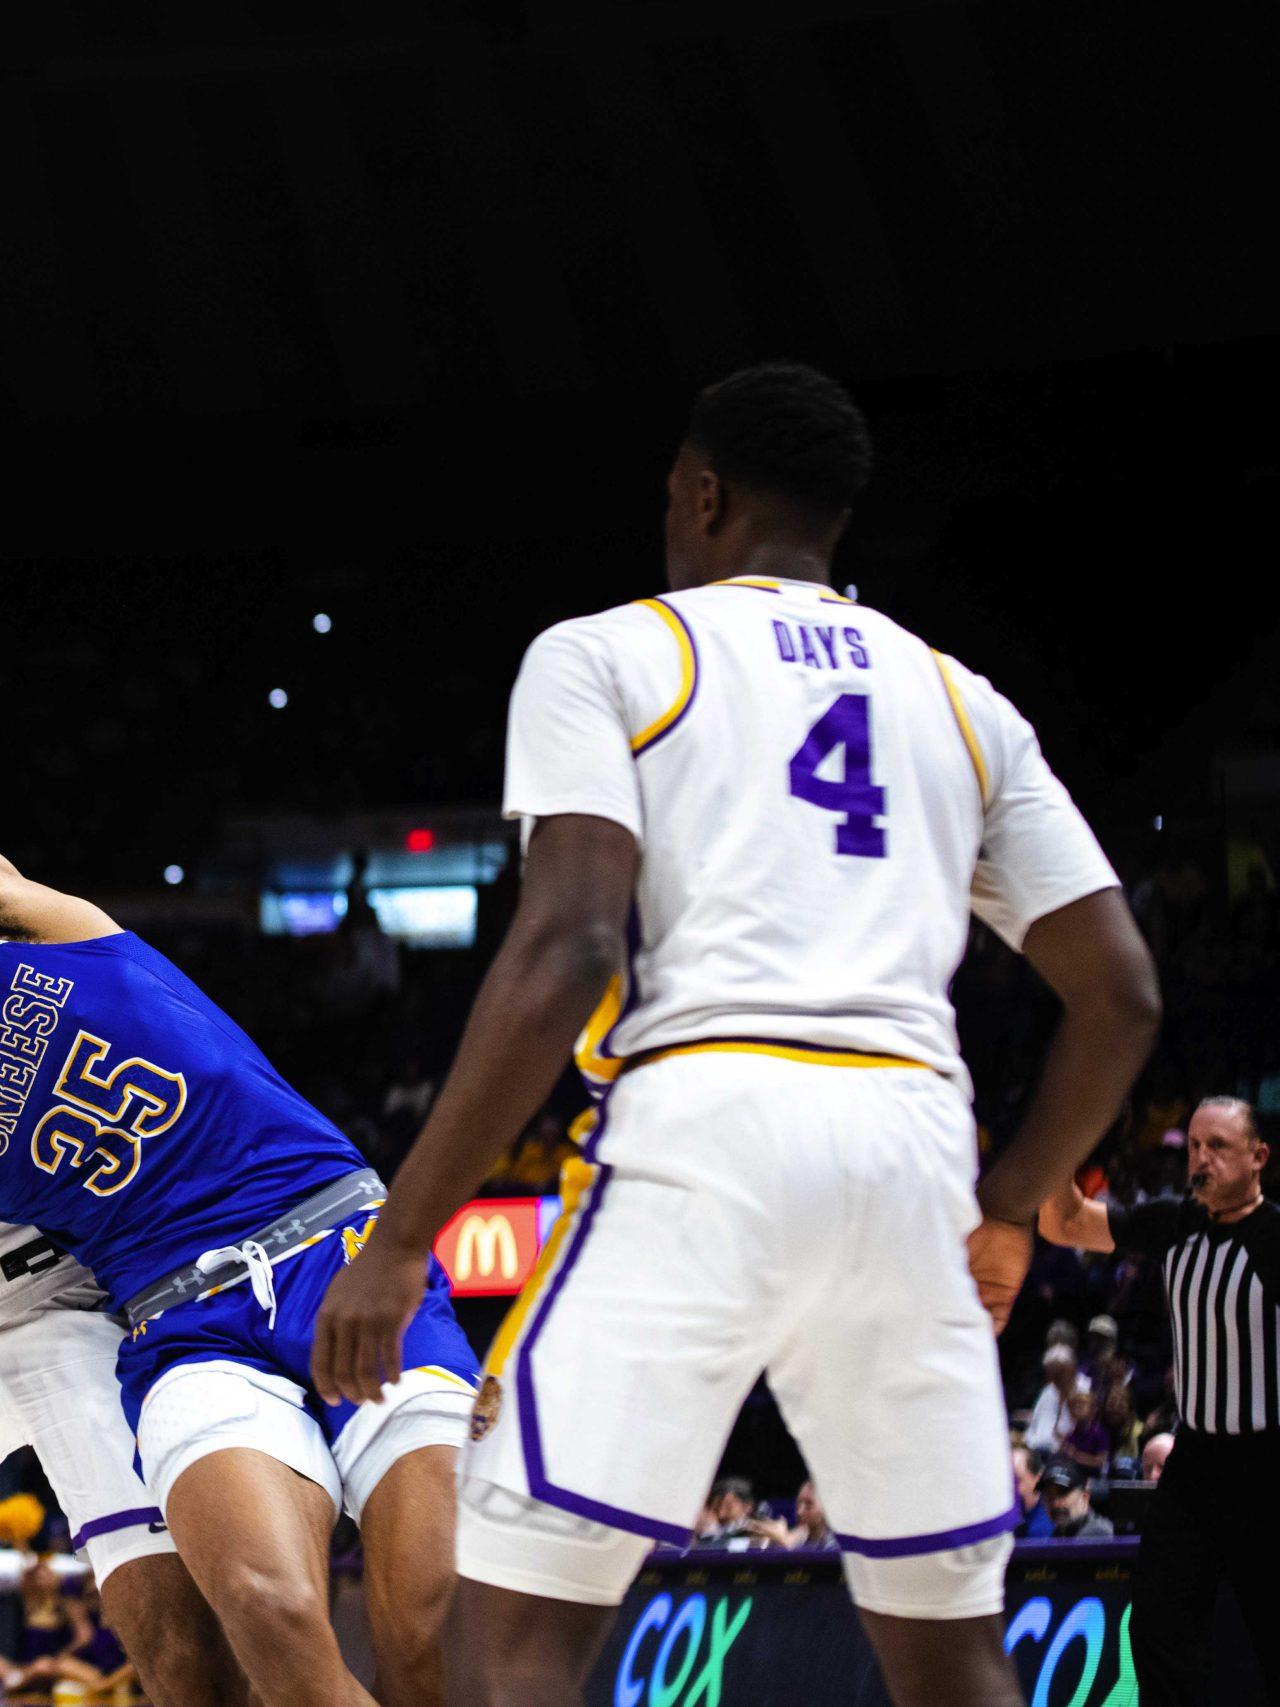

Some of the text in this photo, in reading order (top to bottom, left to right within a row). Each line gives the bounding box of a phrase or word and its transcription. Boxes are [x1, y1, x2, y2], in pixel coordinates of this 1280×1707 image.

[772, 620, 870, 669] DAYS
[789, 693, 887, 858] 4
[31, 1029, 187, 1197] 35
[614, 1592, 753, 1707] COX
